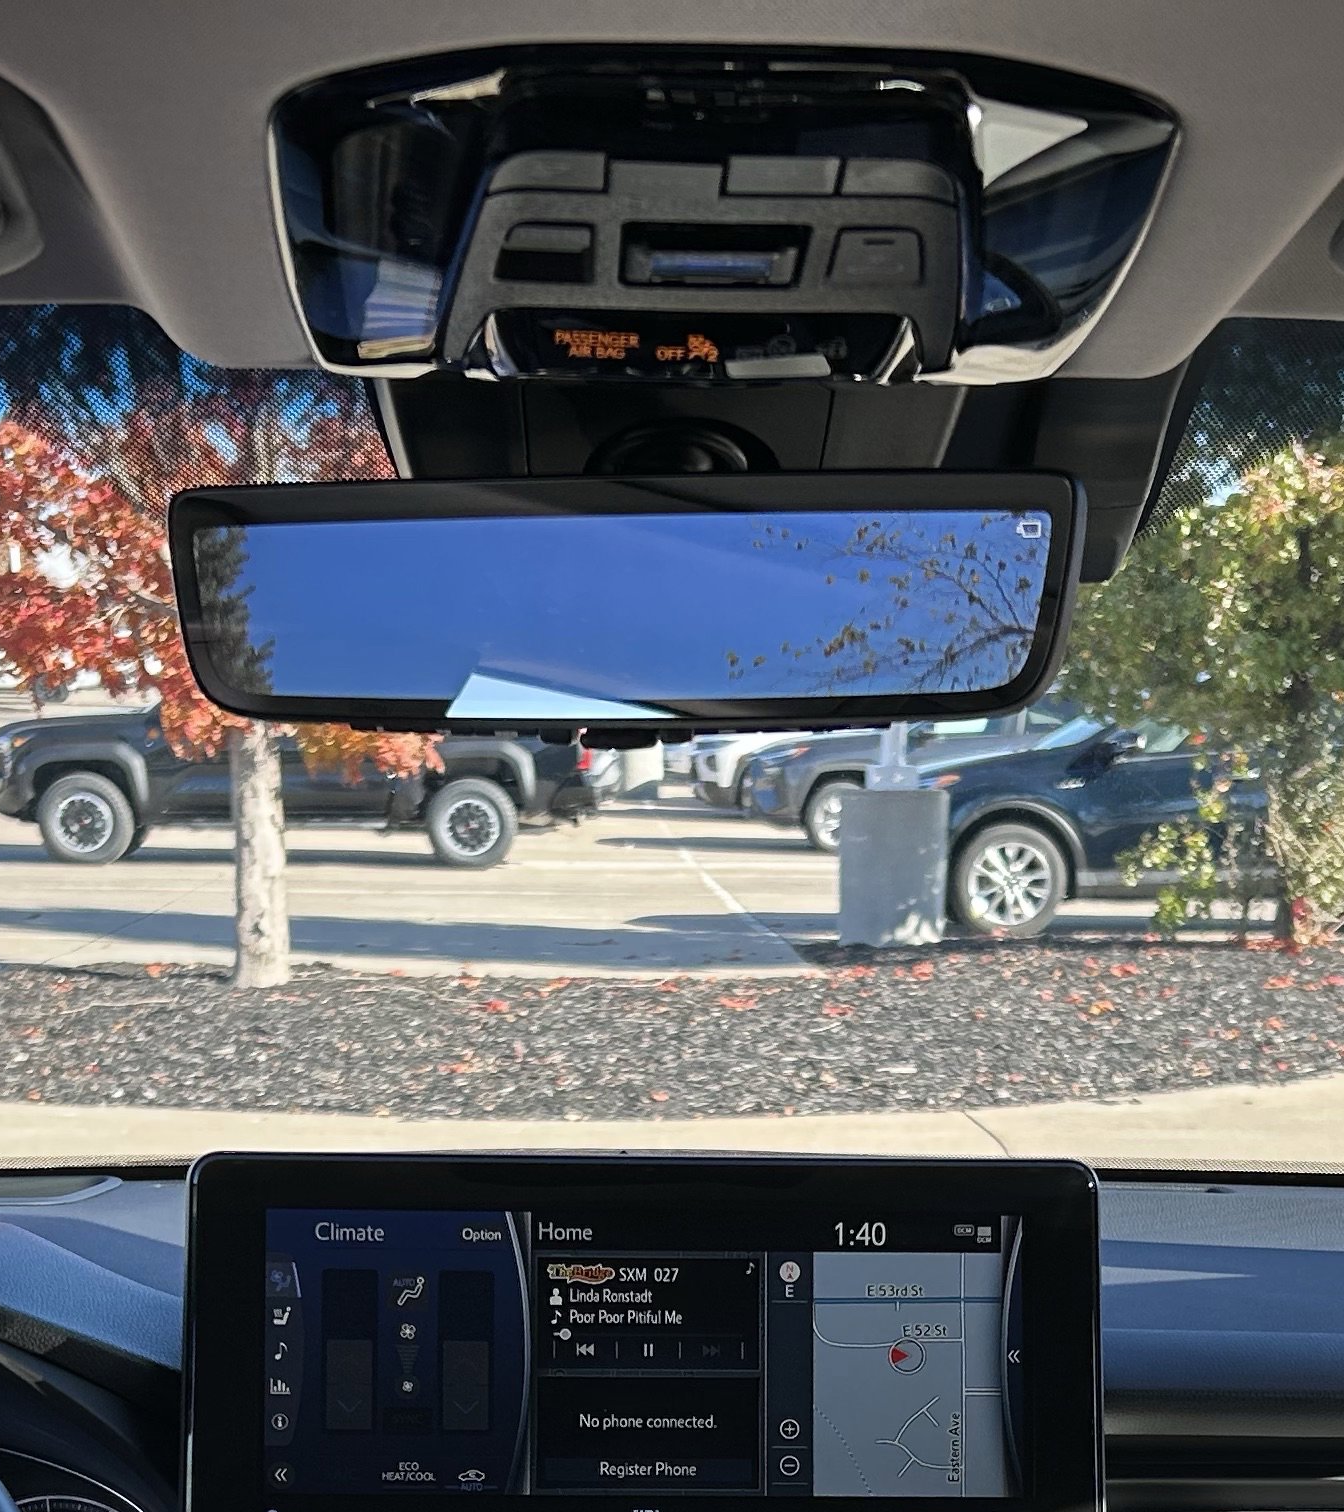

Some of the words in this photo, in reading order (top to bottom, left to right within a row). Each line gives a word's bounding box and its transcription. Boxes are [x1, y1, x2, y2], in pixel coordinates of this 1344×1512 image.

[554, 331, 640, 348] PASSENGER
[567, 346, 592, 359] AIR
[594, 346, 625, 359] BAG
[656, 347, 685, 361] OFF
[314, 1221, 385, 1242] Climate
[462, 1227, 502, 1243] Option
[538, 1221, 593, 1241] Home
[834, 1221, 887, 1247] 1:40
[619, 1267, 647, 1282] SXM
[654, 1267, 679, 1282] 027
[569, 1287, 600, 1303] Linda
[603, 1287, 653, 1303] Ronstadt
[785, 1284, 795, 1298] E
[867, 1285, 875, 1296] E
[879, 1284, 907, 1297] 53rd
[911, 1284, 923, 1297] St
[569, 1309, 595, 1324] Poor
[598, 1309, 625, 1324] Poor
[627, 1309, 662, 1324] Pitiful
[664, 1309, 683, 1325] Me
[903, 1325, 911, 1337] E
[914, 1325, 931, 1337] 52
[934, 1325, 948, 1337] St
[579, 1413, 600, 1428] No
[602, 1413, 643, 1431] phone
[646, 1413, 718, 1429] connected.
[948, 1413, 961, 1436] Ave
[398, 1461, 420, 1472] ECO
[947, 1438, 960, 1483] Eastern
[381, 1471, 437, 1483] HEAT/COOL
[599, 1461, 652, 1479] Register
[655, 1461, 697, 1477] Phone
[460, 1482, 484, 1492] AUTO
